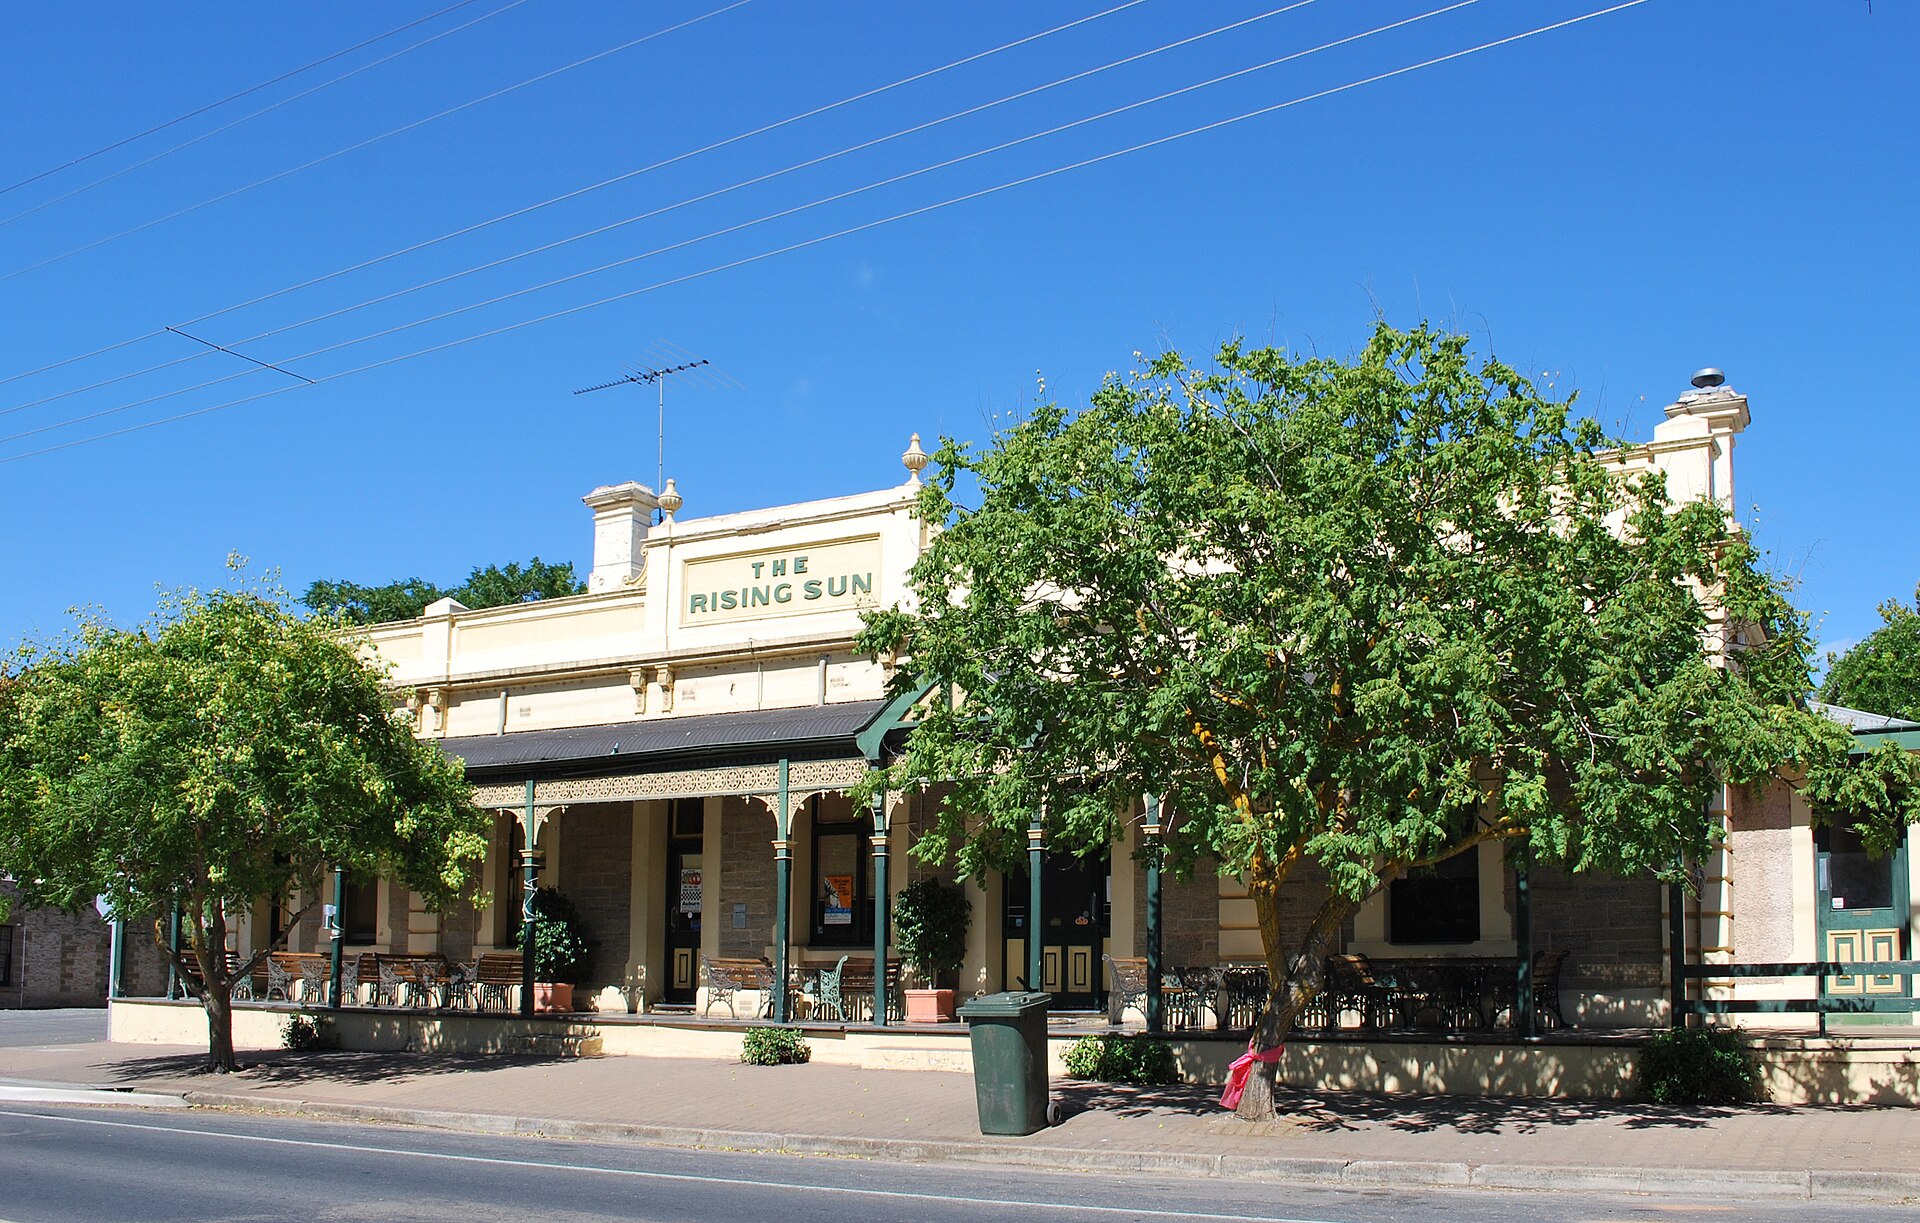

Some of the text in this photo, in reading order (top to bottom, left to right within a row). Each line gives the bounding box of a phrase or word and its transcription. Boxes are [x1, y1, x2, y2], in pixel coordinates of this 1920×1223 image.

[752, 556, 808, 579] THE
[690, 573, 872, 613] RISING SUN
